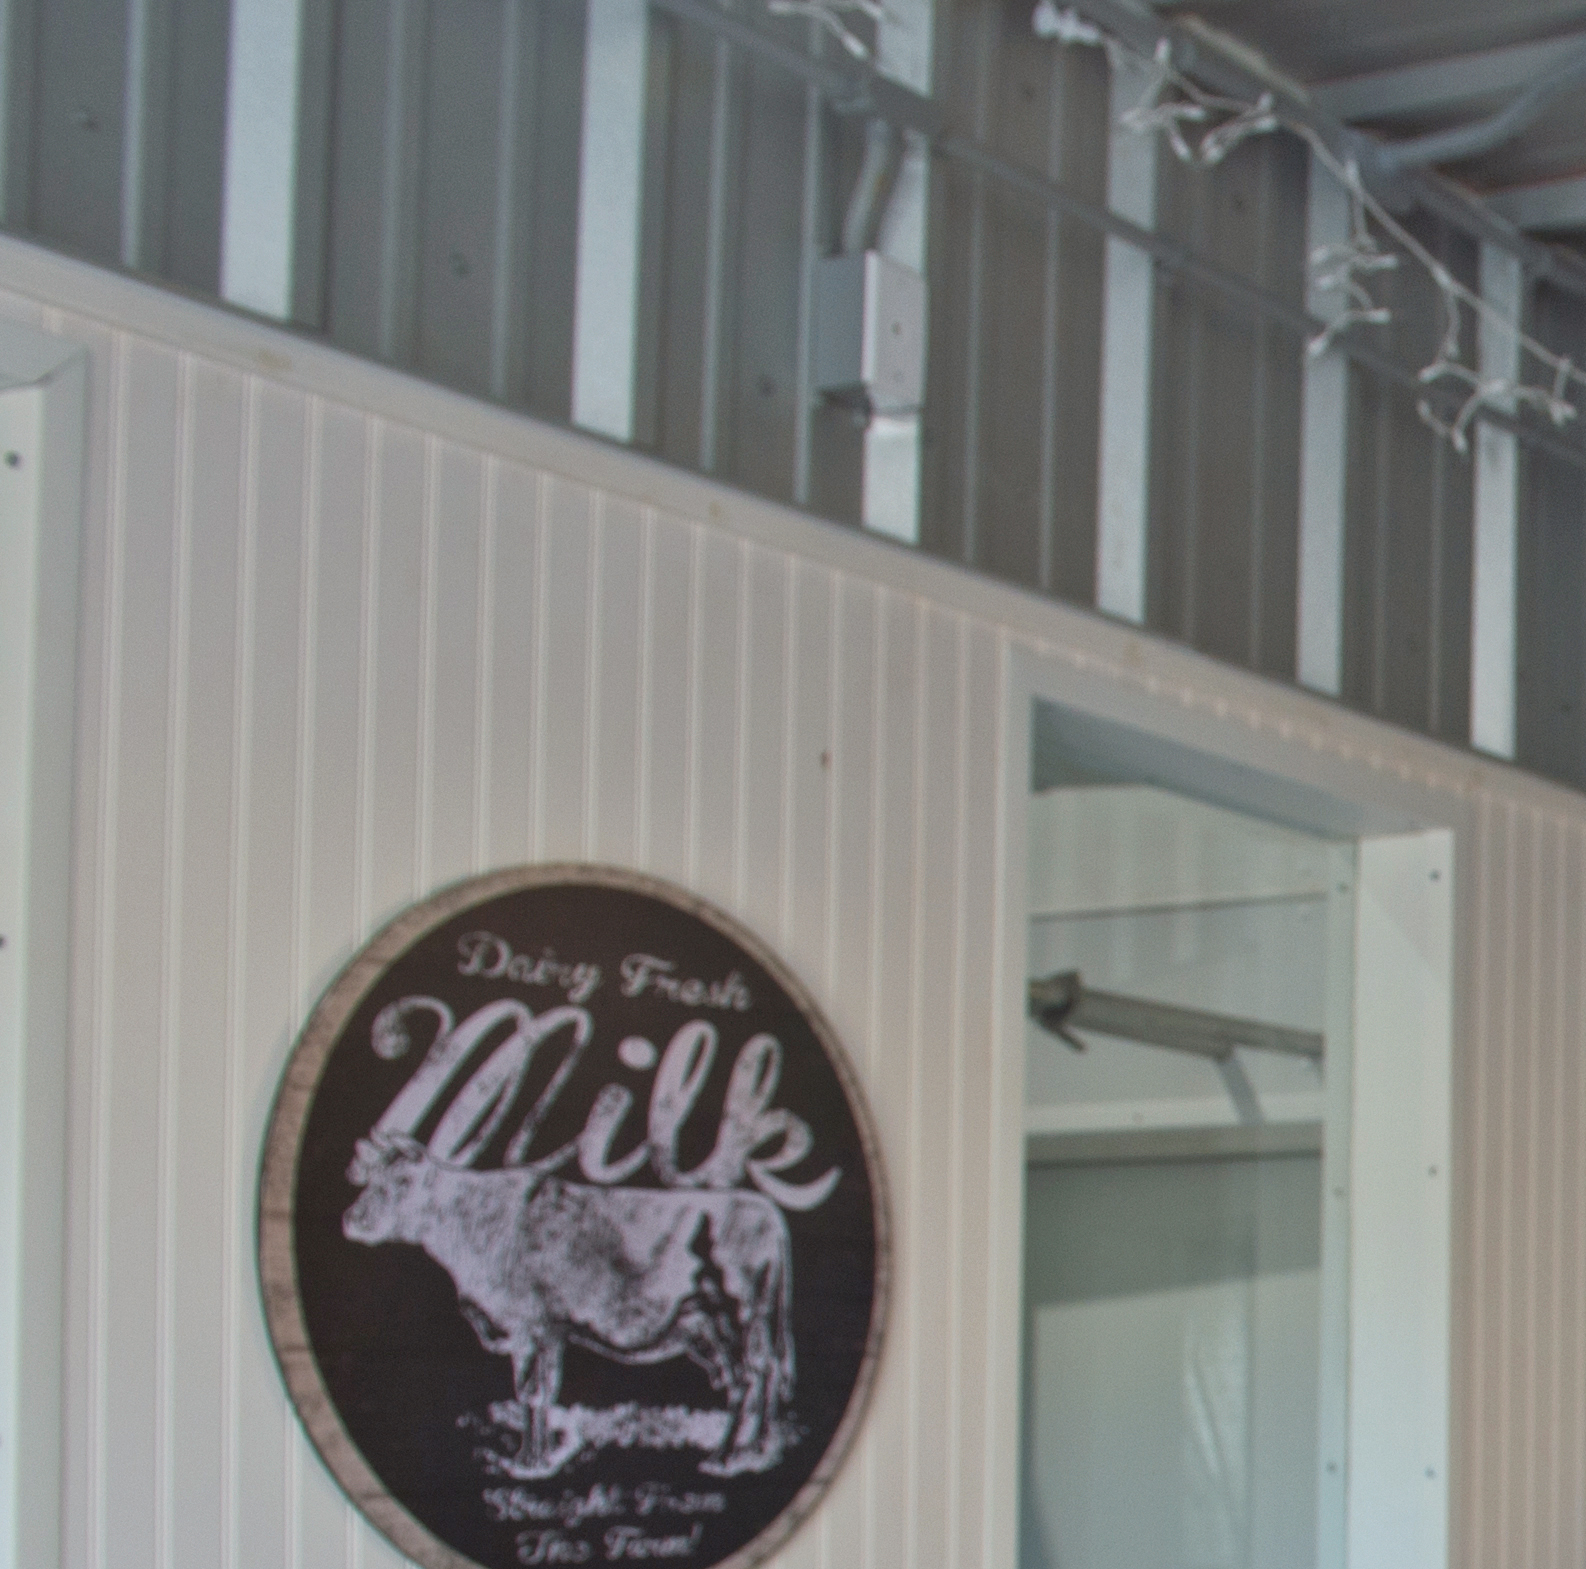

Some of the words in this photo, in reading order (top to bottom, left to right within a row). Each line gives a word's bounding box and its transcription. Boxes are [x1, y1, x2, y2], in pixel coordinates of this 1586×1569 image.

[457, 930, 601, 1003] Dairy
[619, 952, 753, 1011] Fresh
[371, 996, 842, 1209] Milk
[482, 1482, 626, 1528] Straight
[634, 1481, 726, 1515] From
[515, 1529, 592, 1565] The
